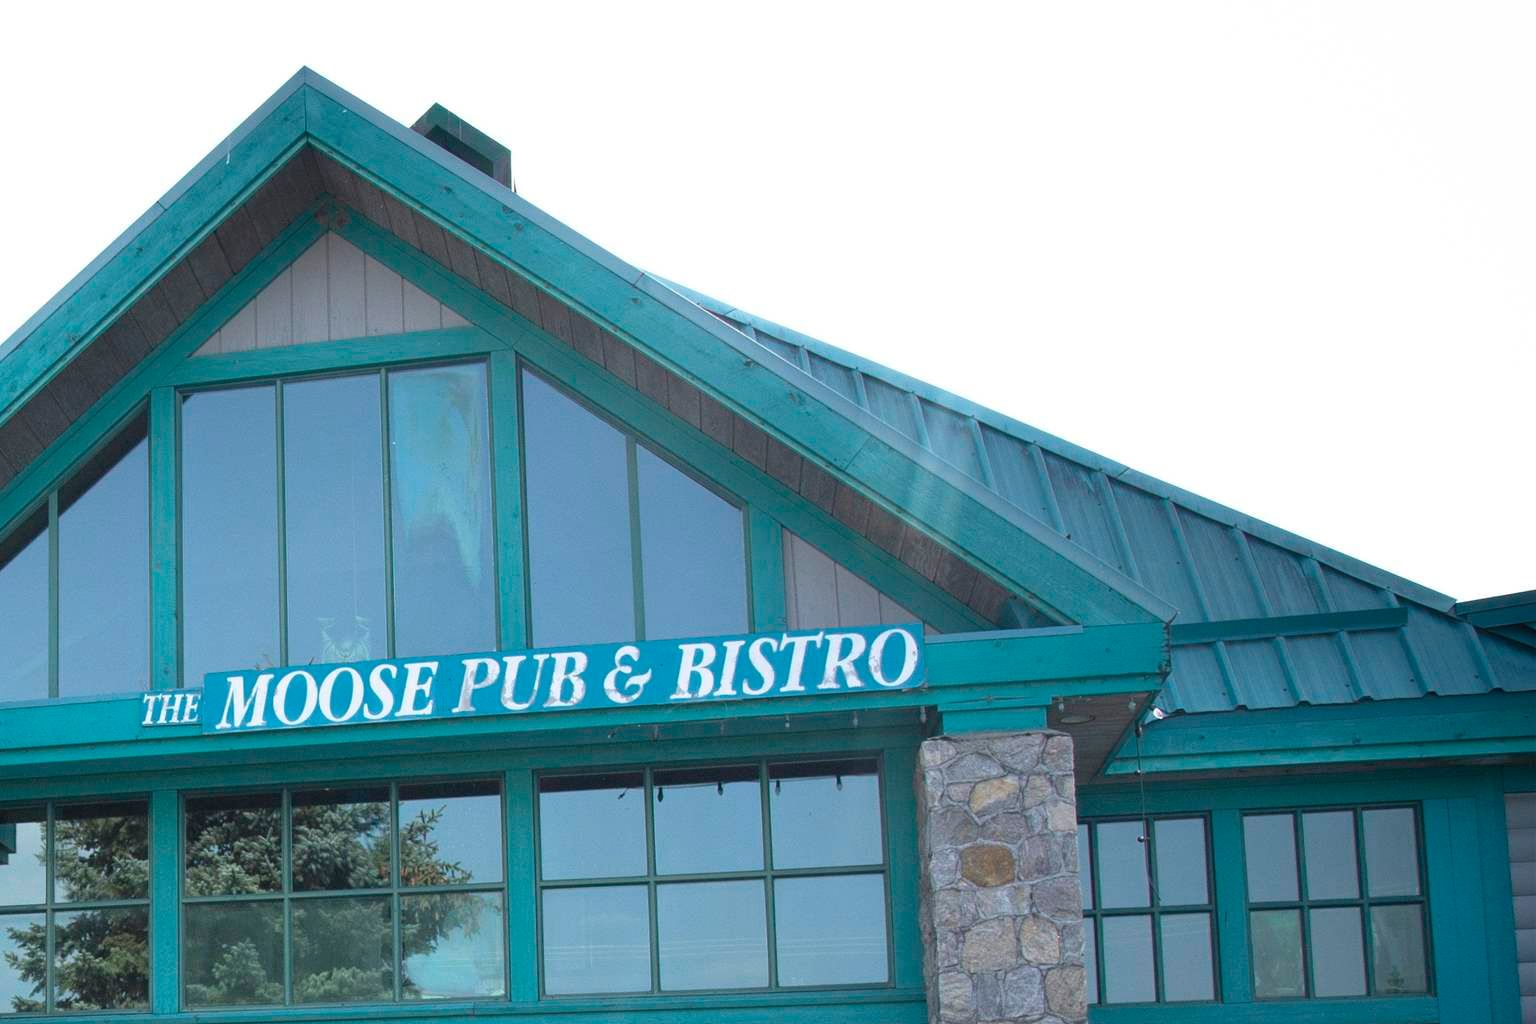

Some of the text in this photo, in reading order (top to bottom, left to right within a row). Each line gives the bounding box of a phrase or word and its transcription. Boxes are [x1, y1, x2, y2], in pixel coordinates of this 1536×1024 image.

[142, 628, 918, 730] THE MOOSE PUB & BISTRO
